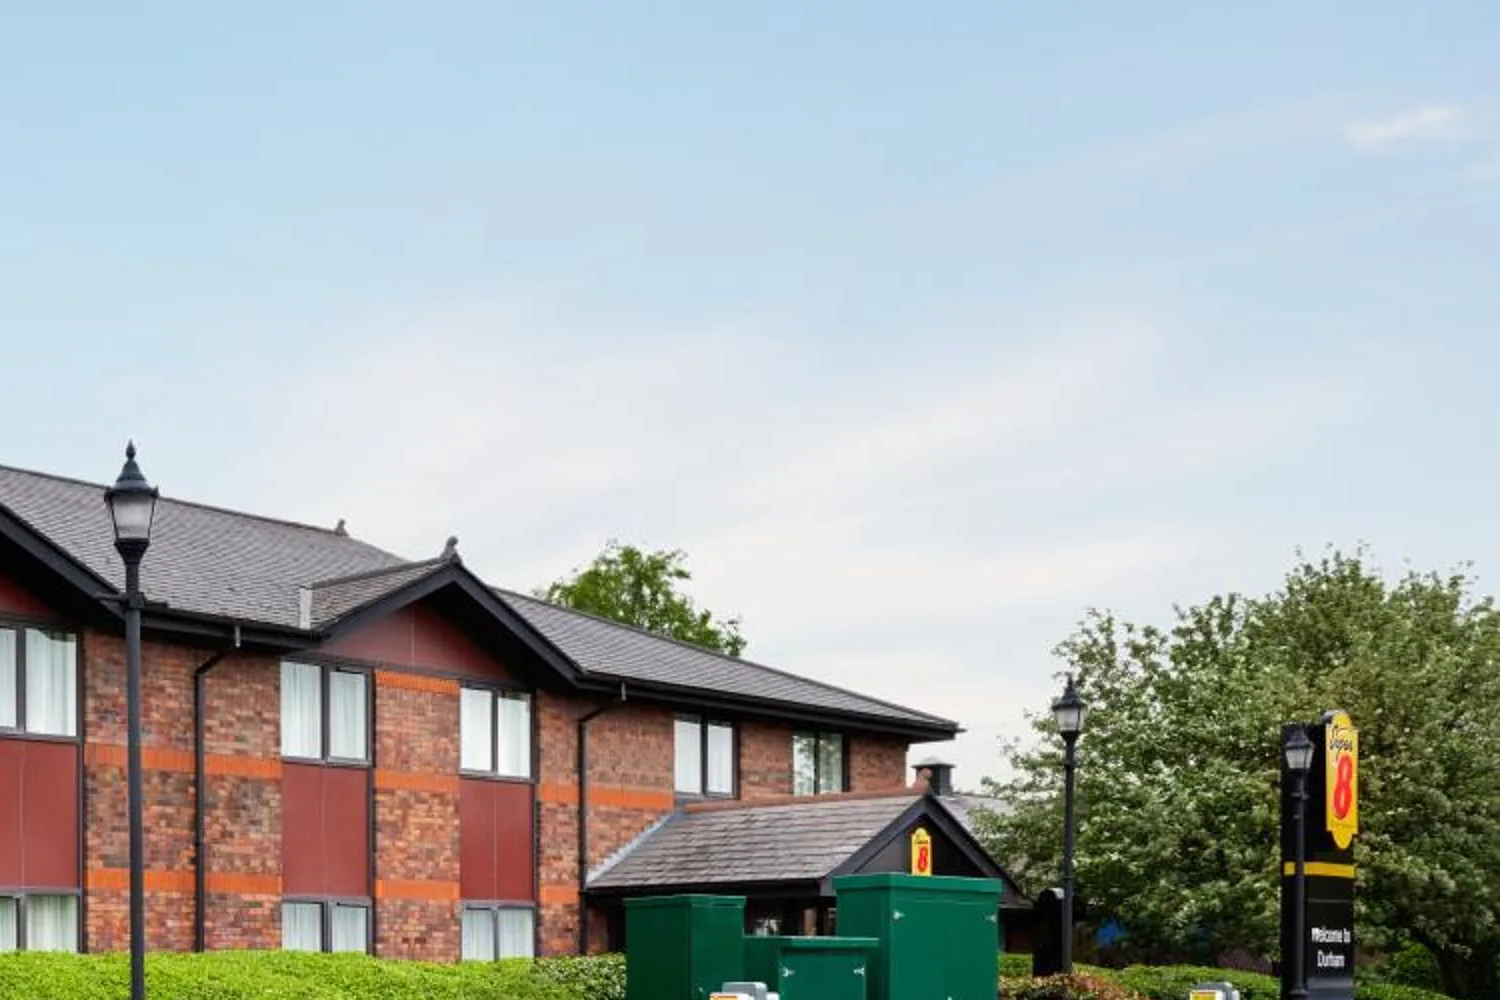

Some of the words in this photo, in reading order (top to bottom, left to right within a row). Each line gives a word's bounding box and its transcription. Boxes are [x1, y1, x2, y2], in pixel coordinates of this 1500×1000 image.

[1333, 753, 1353, 820] 8
[917, 846, 929, 873] 8
[1311, 926, 1342, 943] Welcome
[1317, 949, 1345, 968] Durham
